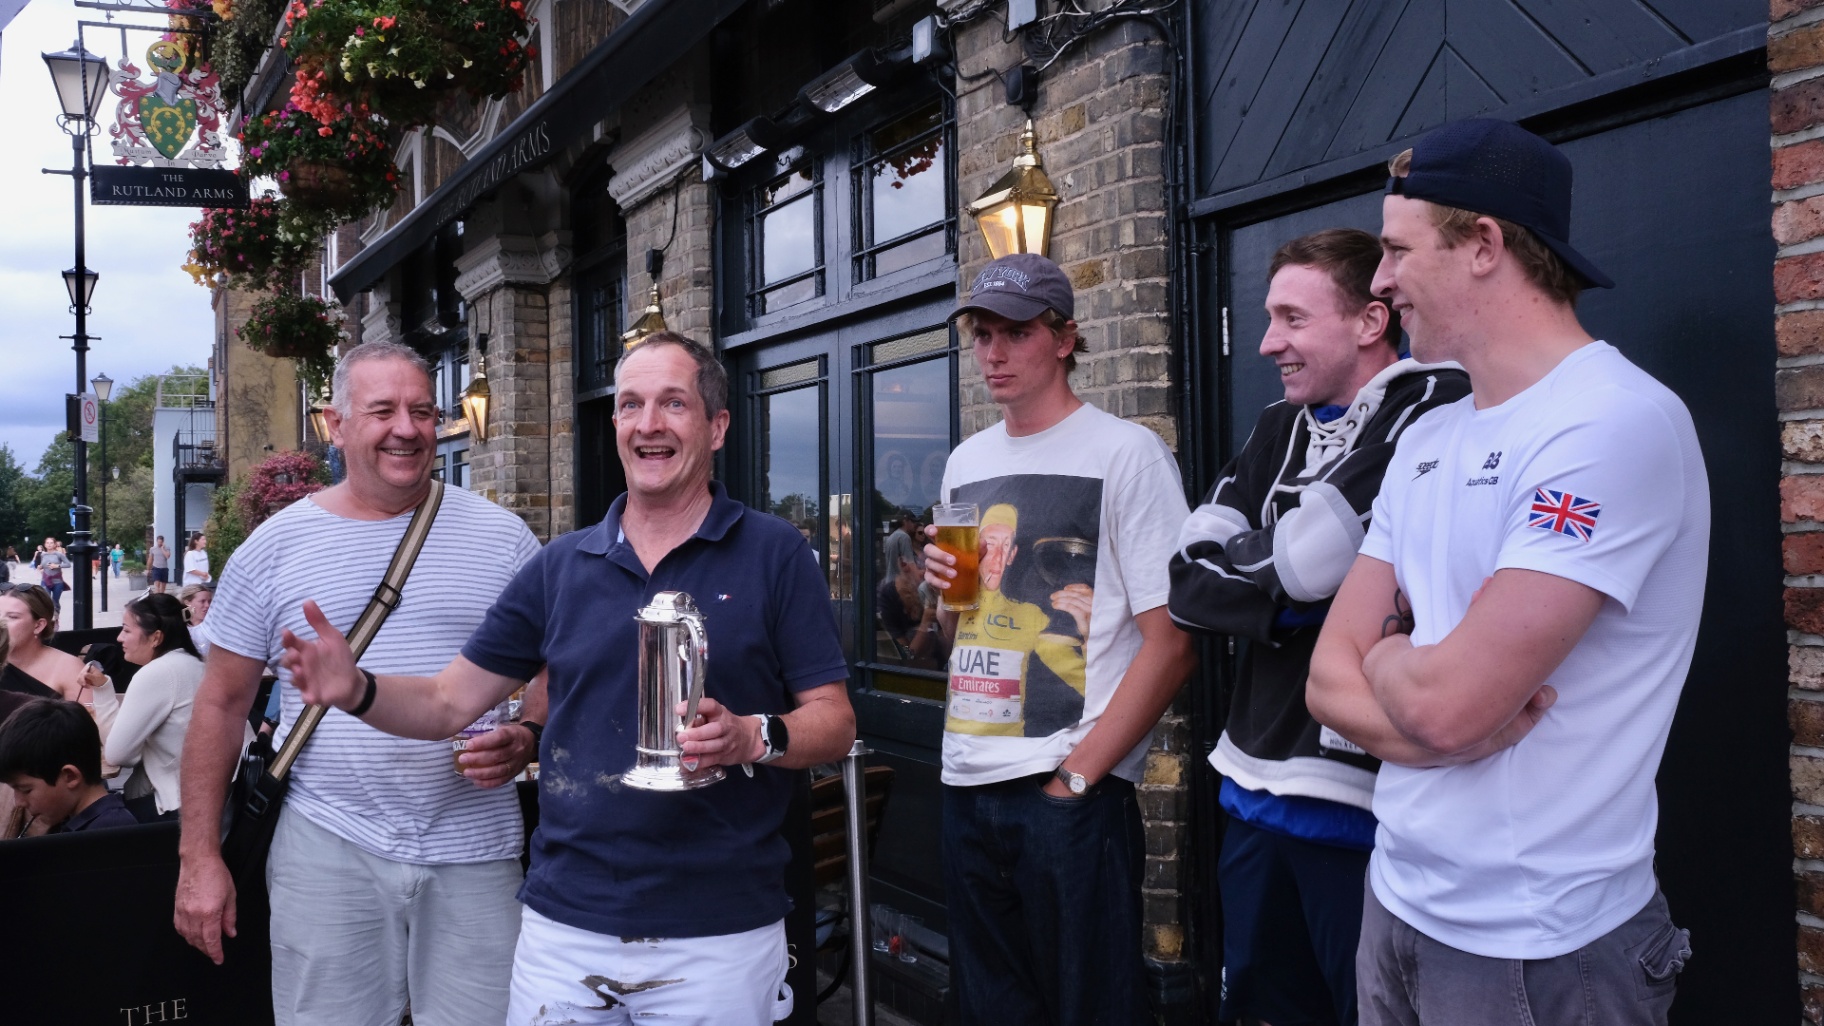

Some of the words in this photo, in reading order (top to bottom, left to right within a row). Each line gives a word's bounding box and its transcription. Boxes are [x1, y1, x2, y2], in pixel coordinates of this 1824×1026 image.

[507, 121, 550, 173] ARMS
[161, 173, 184, 183] THE
[112, 184, 187, 198] RUTLAND
[191, 188, 234, 200] ARMS
[987, 613, 1021, 631] LCL
[959, 648, 1000, 676] UAE
[958, 677, 1000, 694] Emirates
[120, 998, 188, 1026] THE
